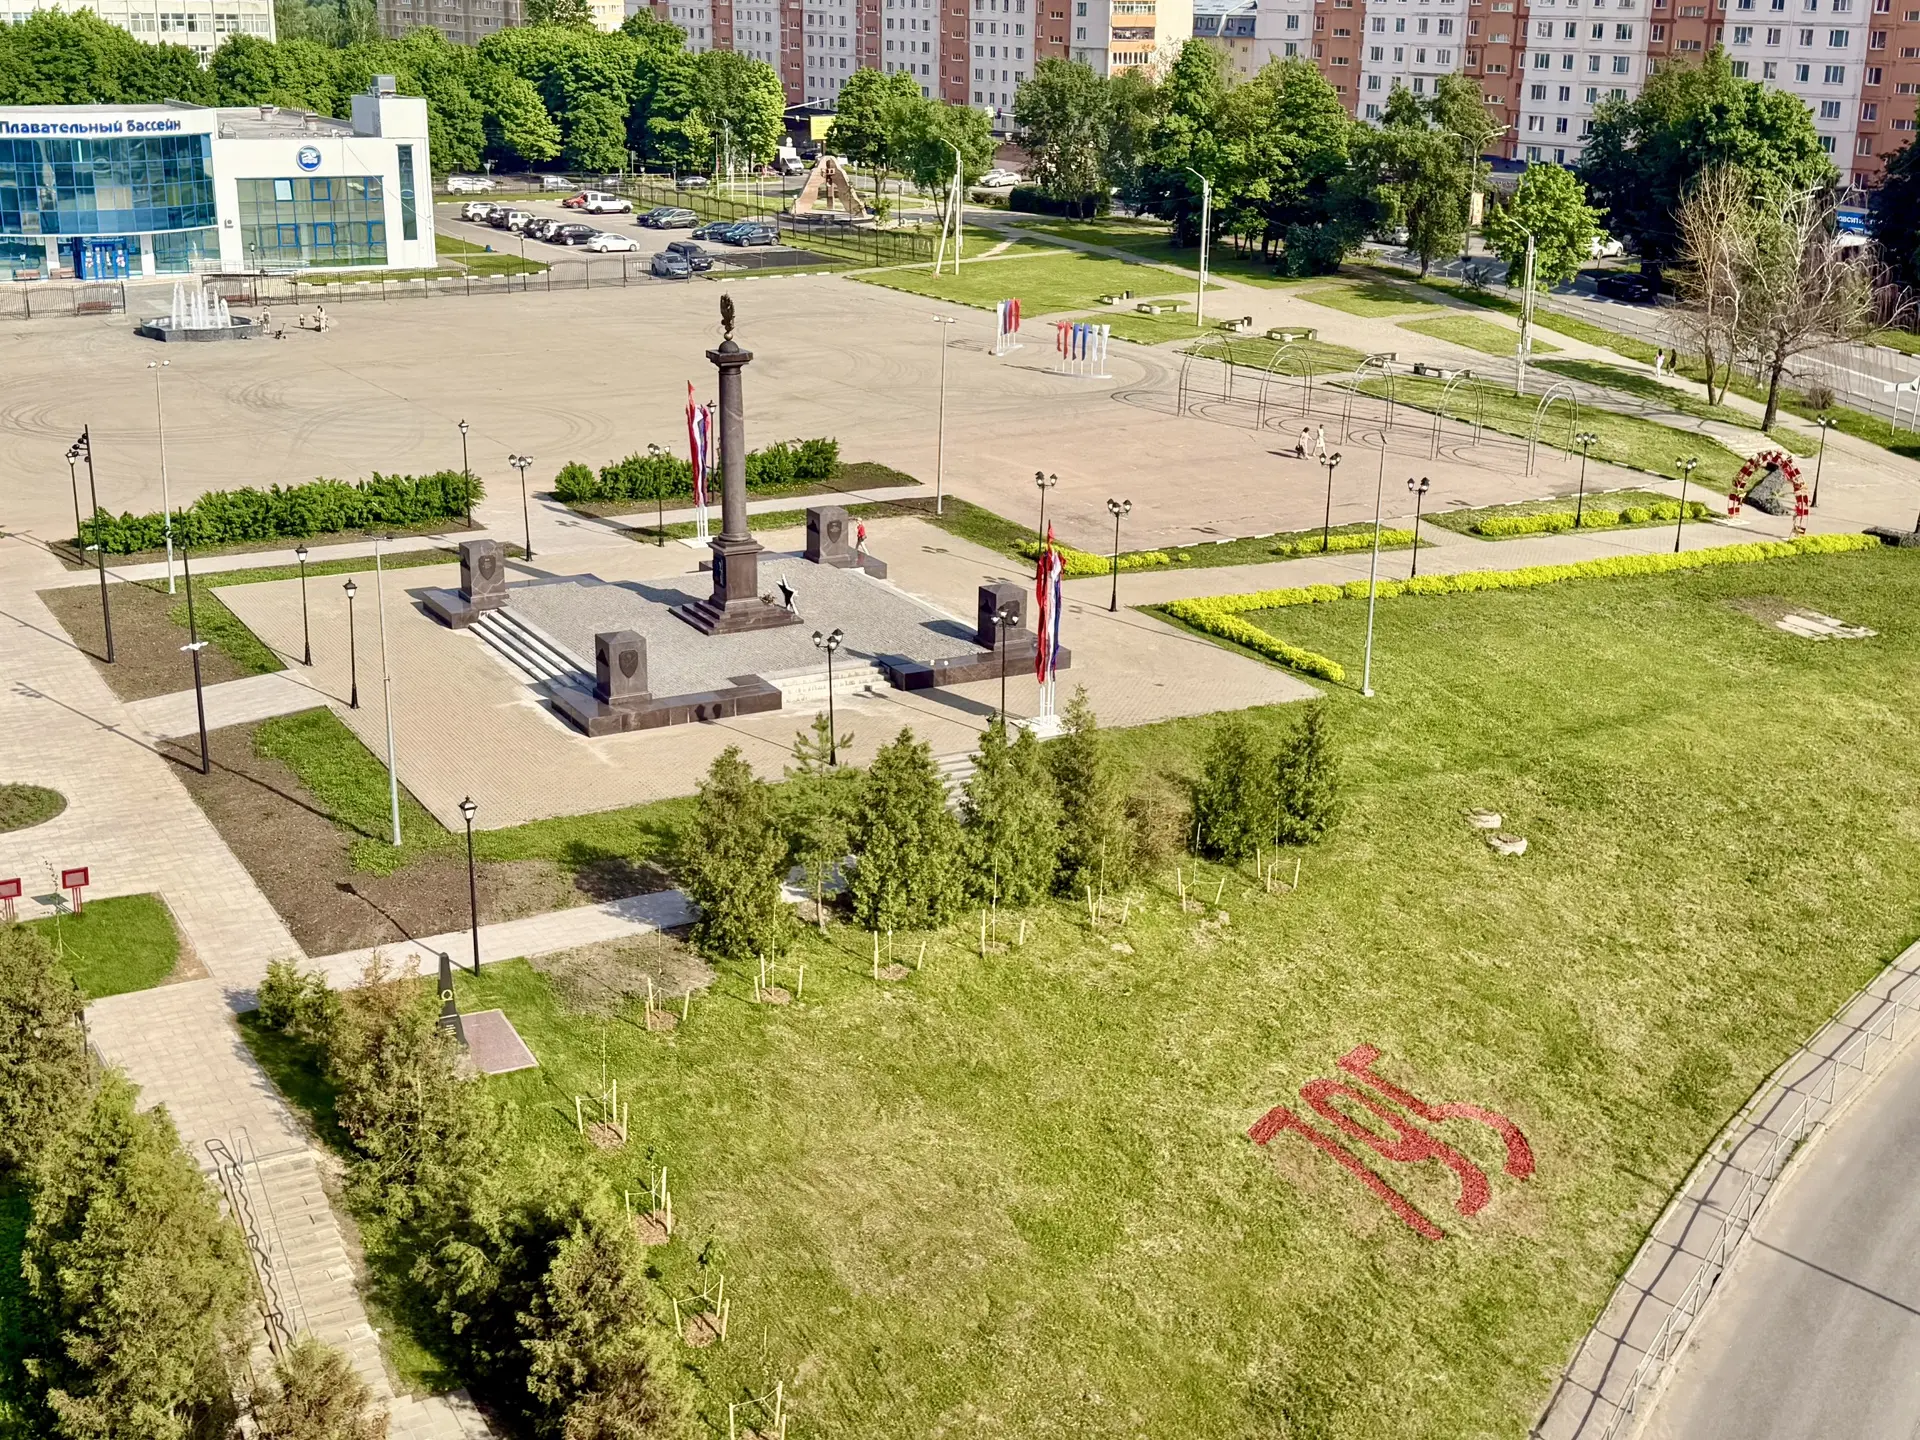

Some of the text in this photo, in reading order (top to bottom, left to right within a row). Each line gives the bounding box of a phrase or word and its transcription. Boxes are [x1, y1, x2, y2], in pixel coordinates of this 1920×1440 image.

[0, 118, 181, 134] Плавательный бассейн
[1248, 1043, 1535, 1242] 195
